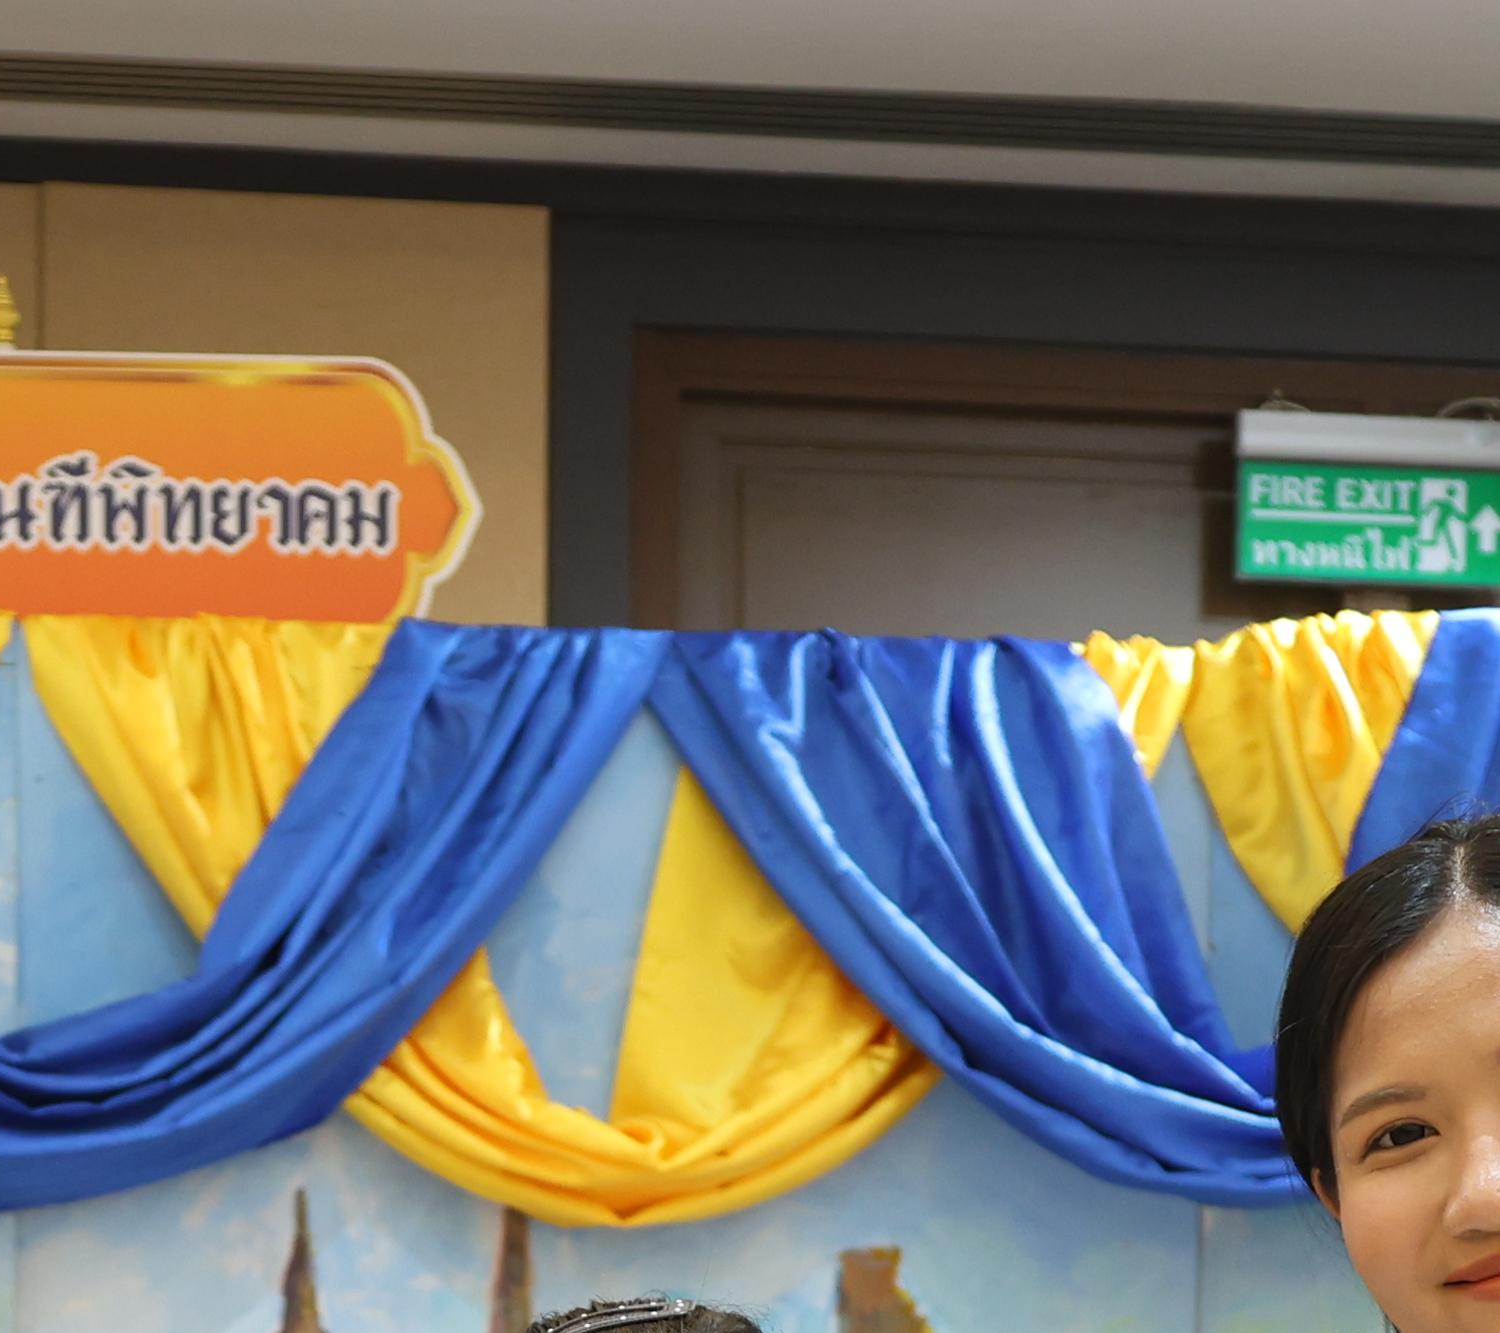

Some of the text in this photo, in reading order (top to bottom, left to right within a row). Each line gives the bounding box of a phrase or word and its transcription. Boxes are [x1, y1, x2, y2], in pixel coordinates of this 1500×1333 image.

[1249, 474, 1416, 510] FIRE EXIT
[1252, 528, 1411, 572] ทางหนีไฟ
